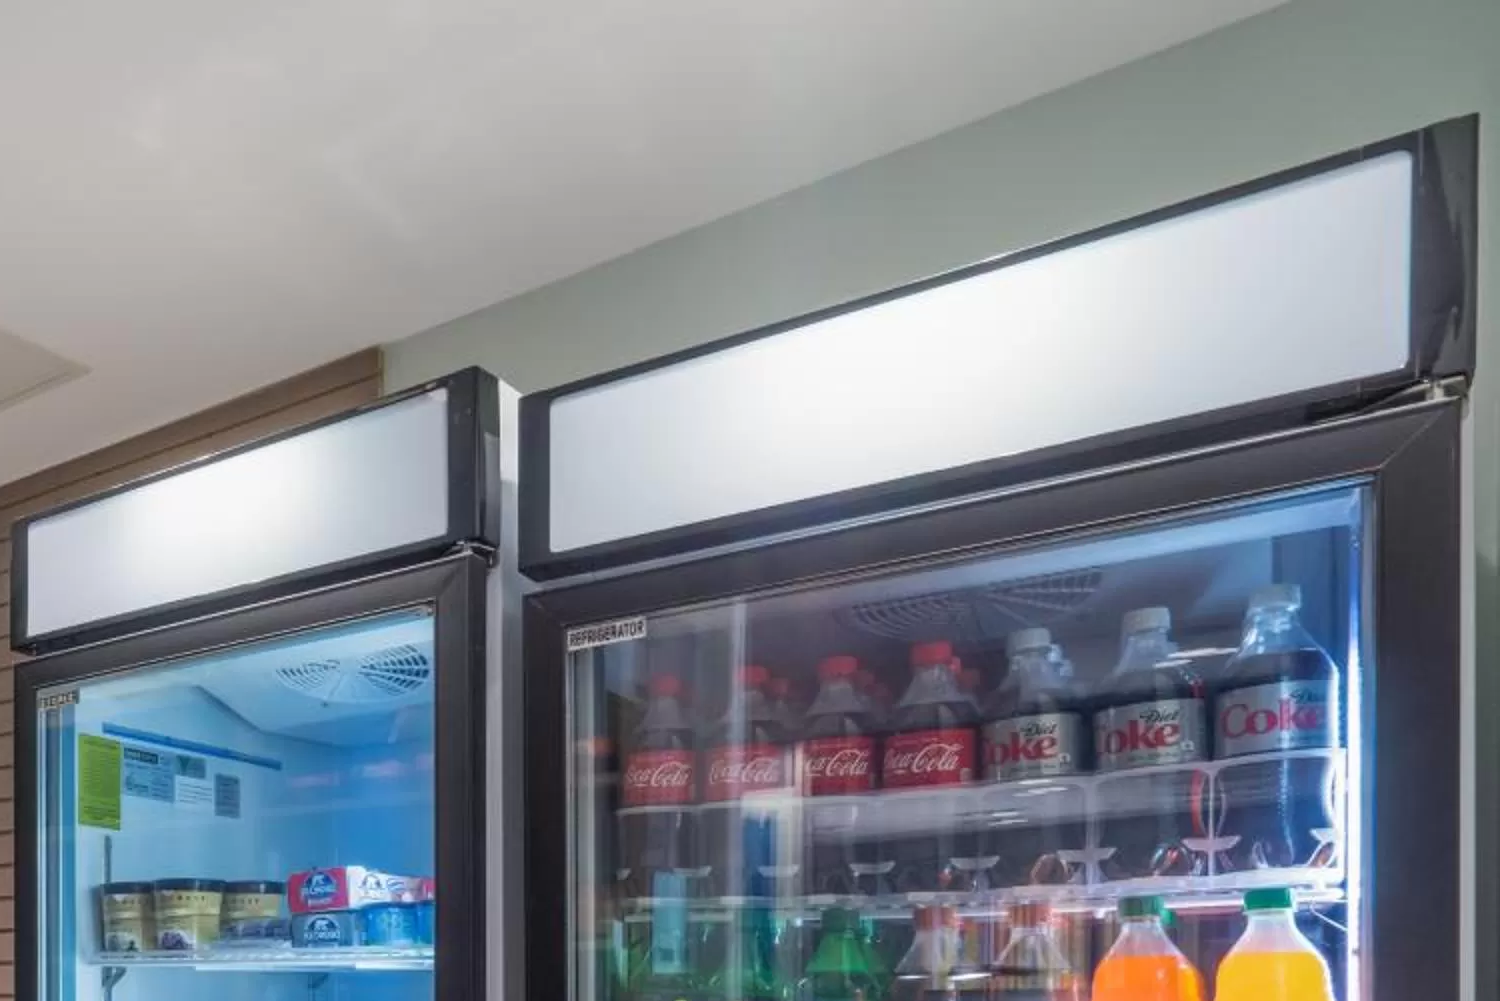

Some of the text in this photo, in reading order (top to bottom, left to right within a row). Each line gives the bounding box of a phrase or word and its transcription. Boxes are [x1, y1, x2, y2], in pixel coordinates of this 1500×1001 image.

[570, 619, 645, 647] REFRIGERATOR
[1219, 697, 1319, 738] Coke
[983, 731, 1058, 764] oke
[1098, 719, 1181, 756] oke
[803, 748, 870, 777] oca-Cola
